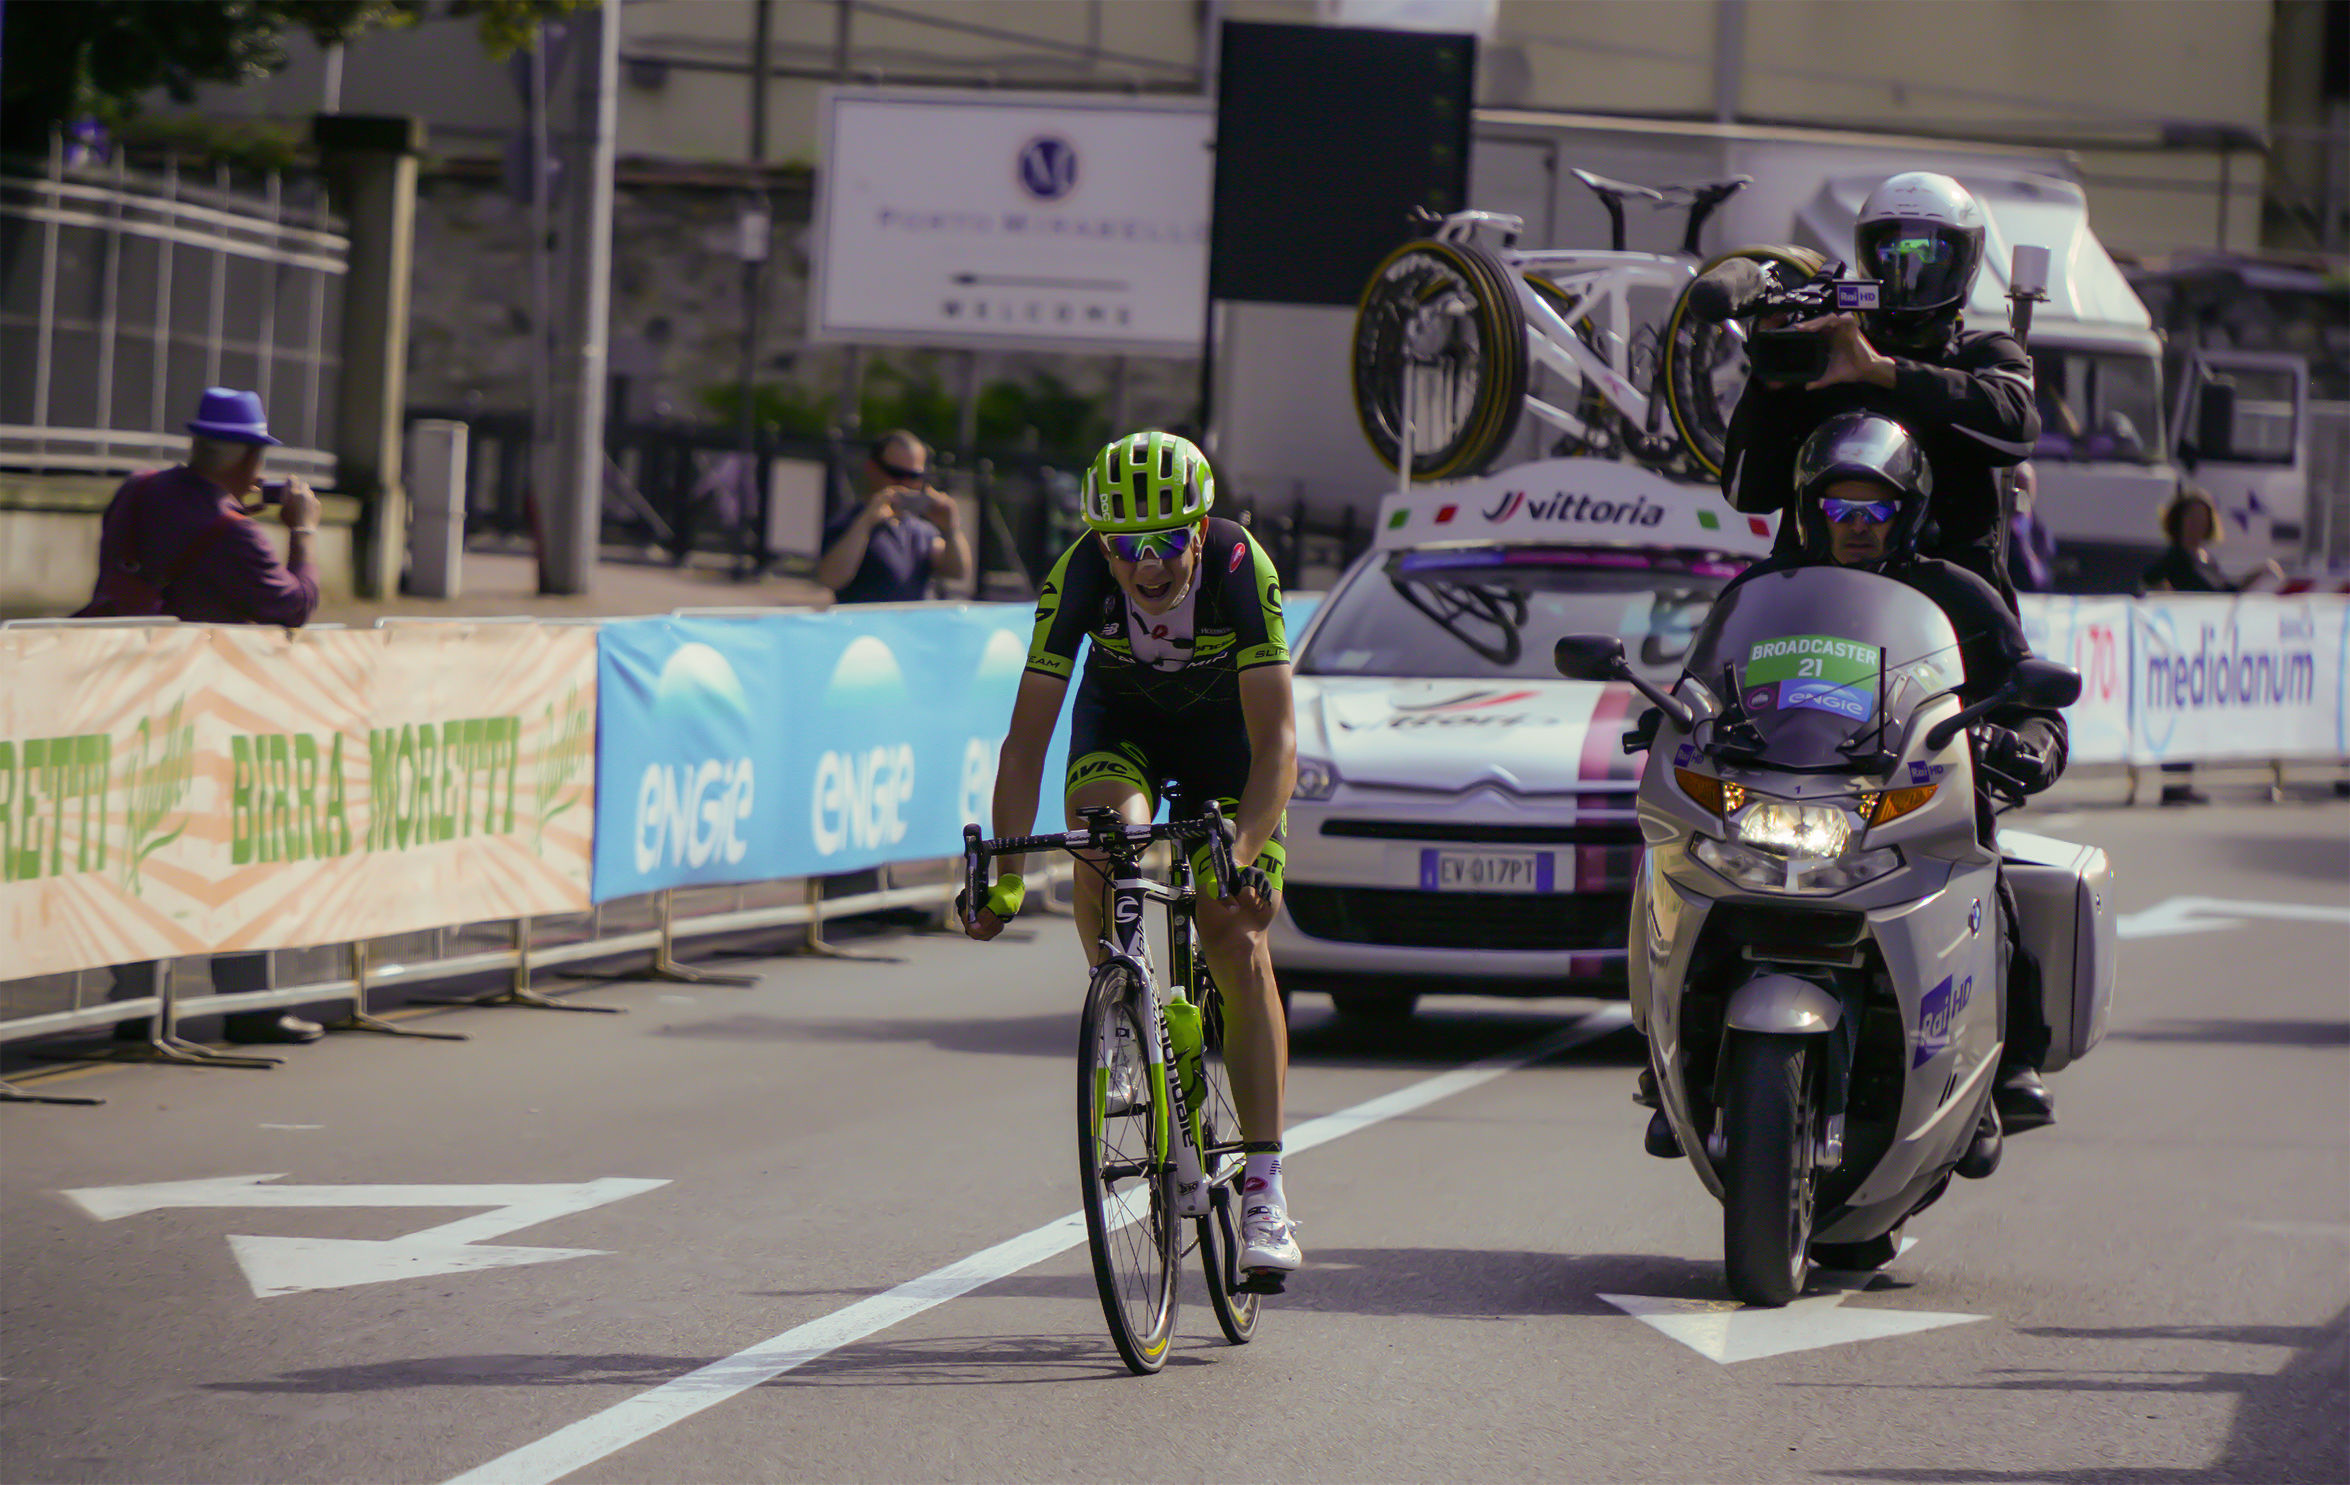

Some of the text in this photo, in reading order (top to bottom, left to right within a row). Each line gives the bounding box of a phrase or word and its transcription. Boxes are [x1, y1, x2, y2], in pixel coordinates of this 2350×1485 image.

[1839, 290, 1876, 302] Rai HD
[1527, 491, 1665, 527] vittoria
[1028, 656, 1061, 668] EAM
[1752, 639, 1877, 665] BROADCASTER
[2147, 621, 2314, 708] mediolanum
[1798, 658, 1822, 677] 21
[1929, 765, 1943, 775] HD
[231, 716, 521, 865] BIRRA MORETTI
[1951, 975, 1973, 1019] HD
